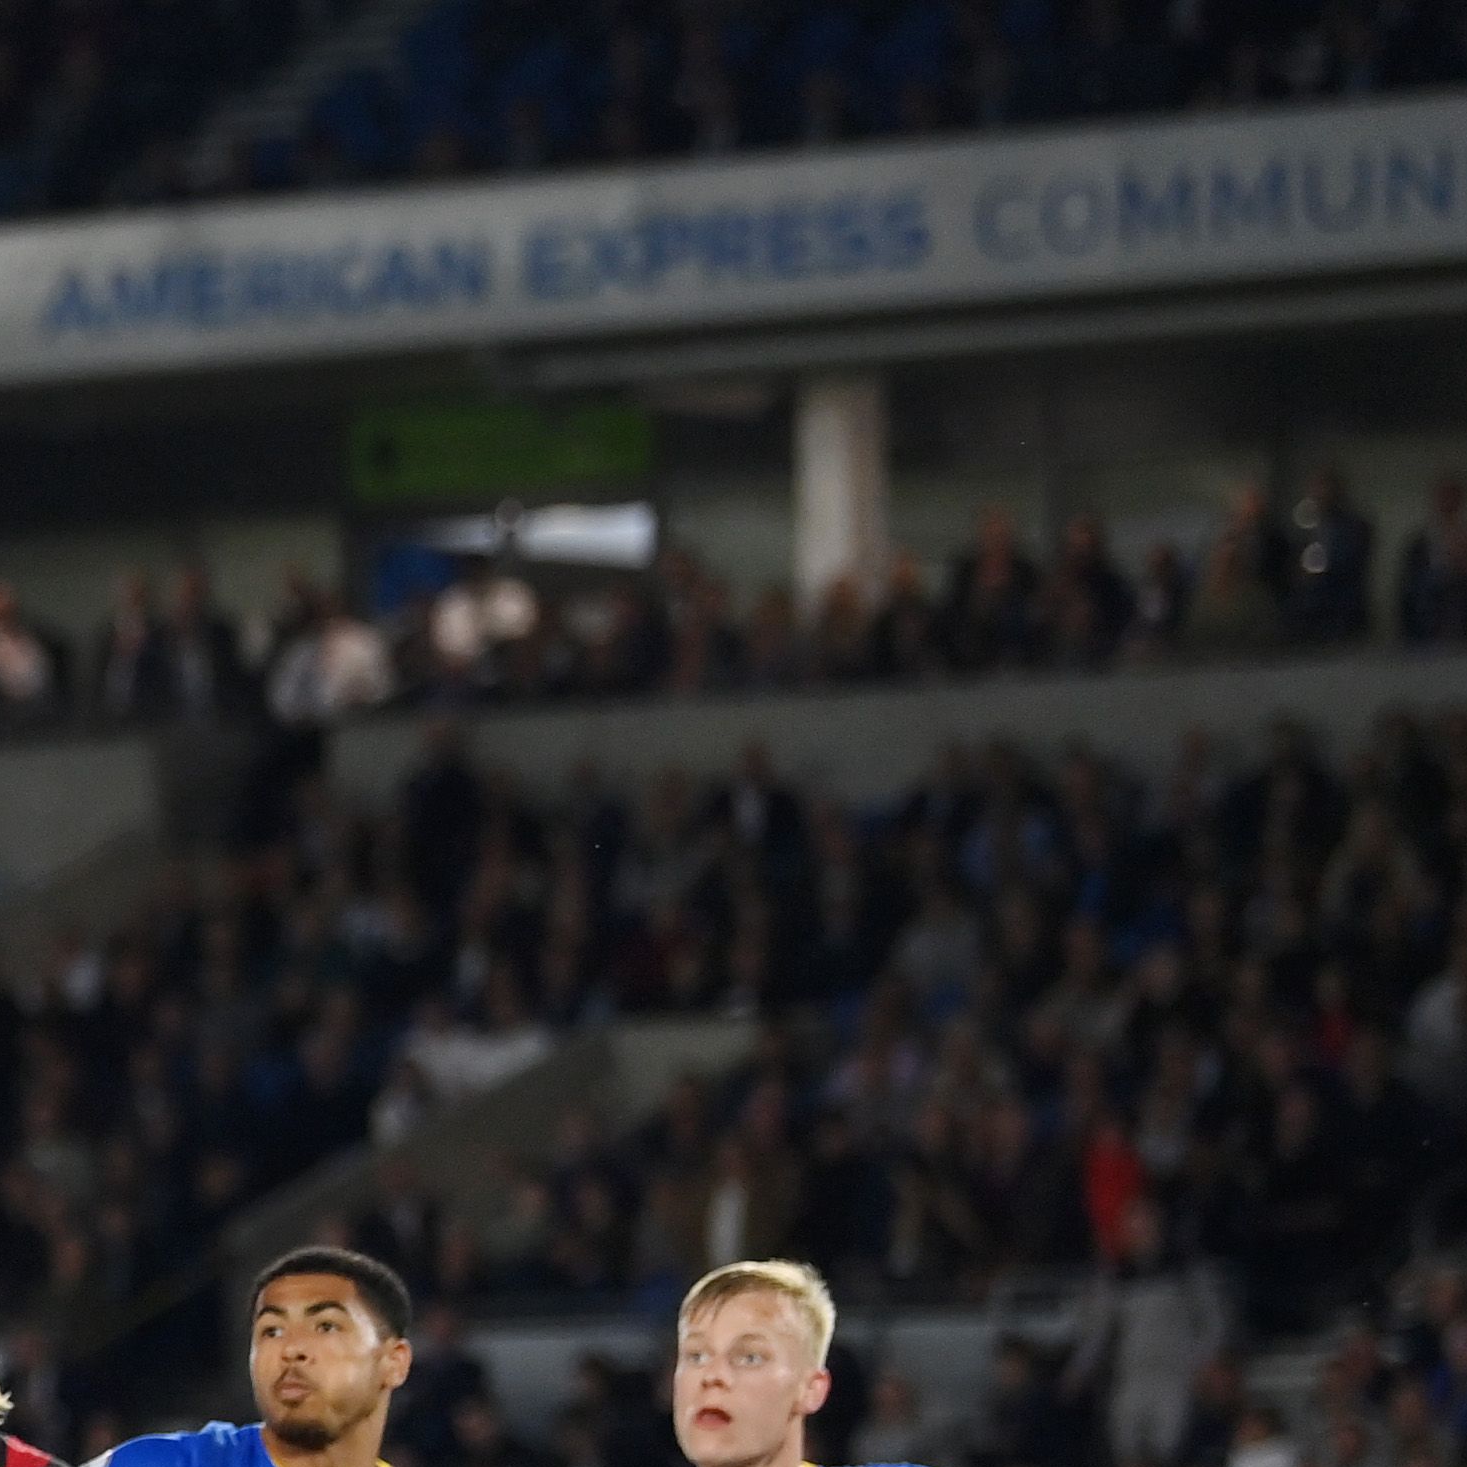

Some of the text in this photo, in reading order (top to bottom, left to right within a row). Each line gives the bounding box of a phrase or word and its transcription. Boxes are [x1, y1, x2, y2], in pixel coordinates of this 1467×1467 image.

[40, 138, 1460, 335] AMERICAN EXPRESS COMMUN
